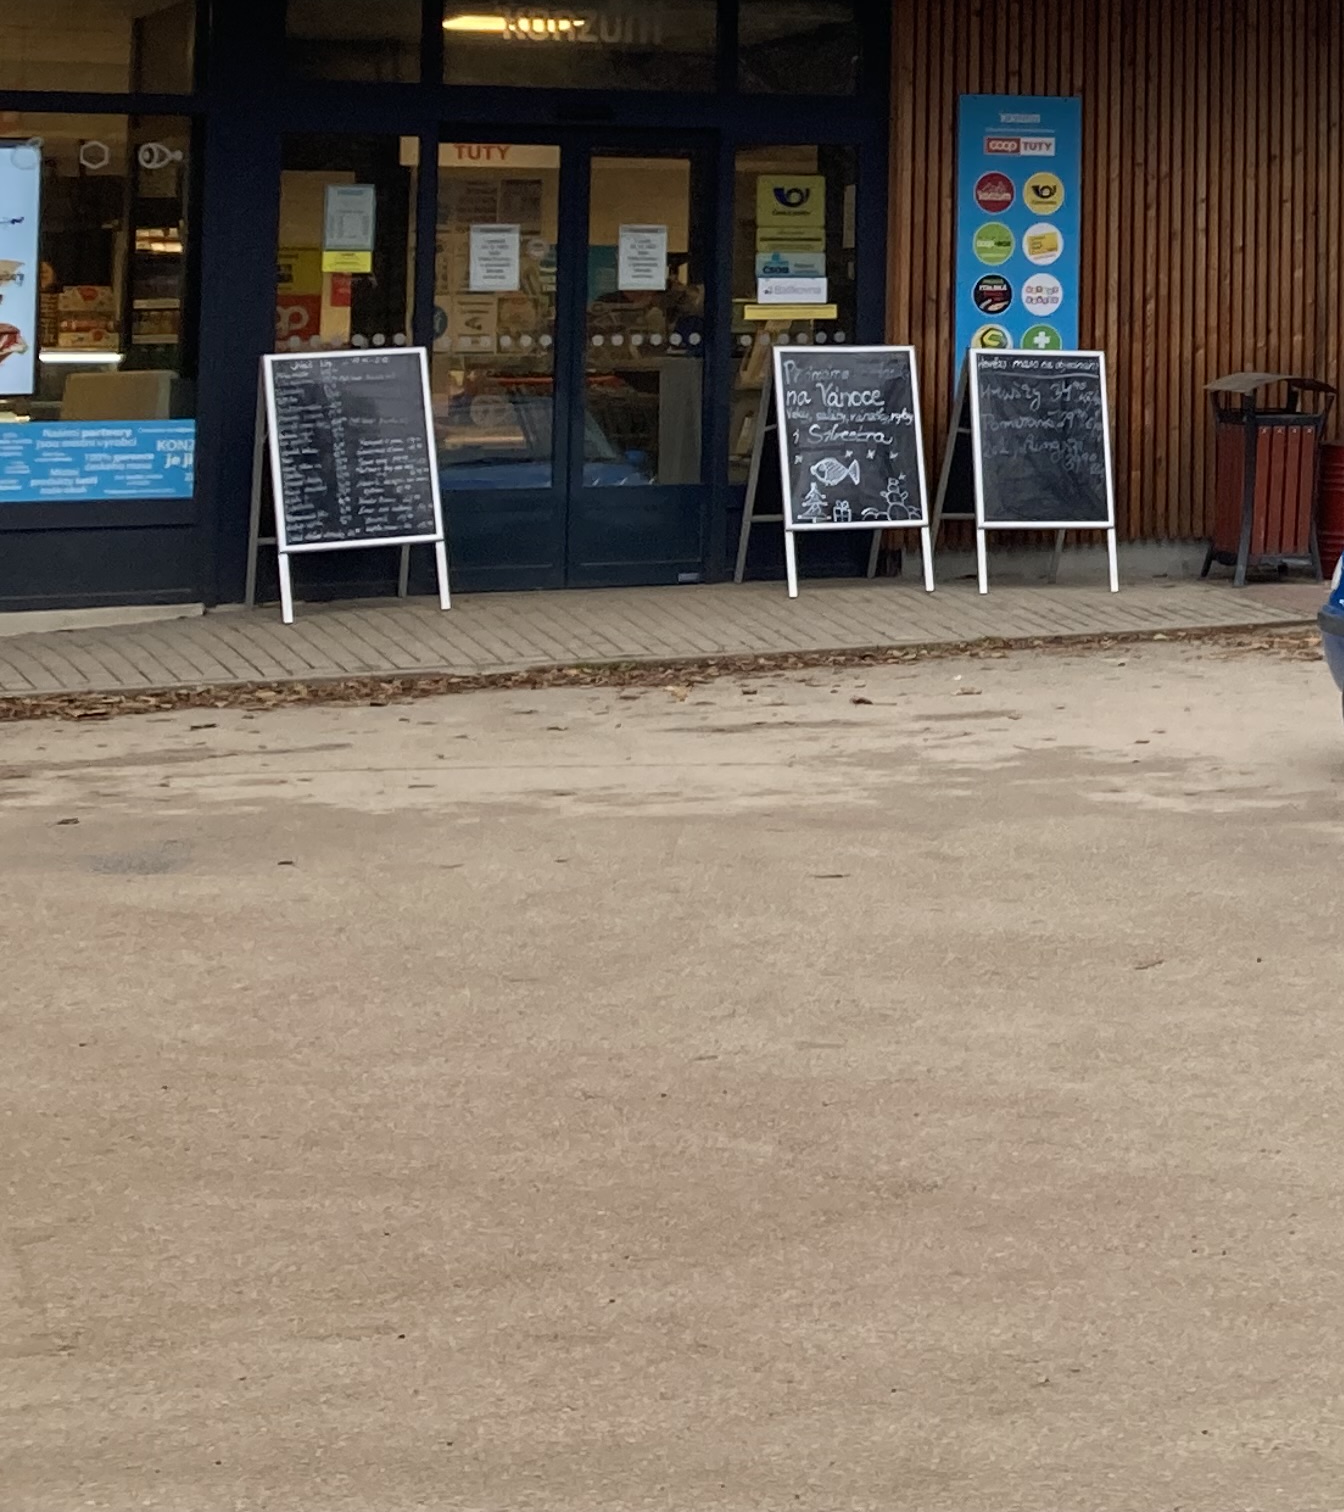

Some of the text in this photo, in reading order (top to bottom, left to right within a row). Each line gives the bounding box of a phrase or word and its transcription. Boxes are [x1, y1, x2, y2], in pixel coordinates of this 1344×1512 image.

[454, 144, 511, 161] TUTY
[1022, 142, 1052, 151] TUTY
[1012, 360, 1039, 369] maso
[786, 382, 885, 407] na Vánoce
